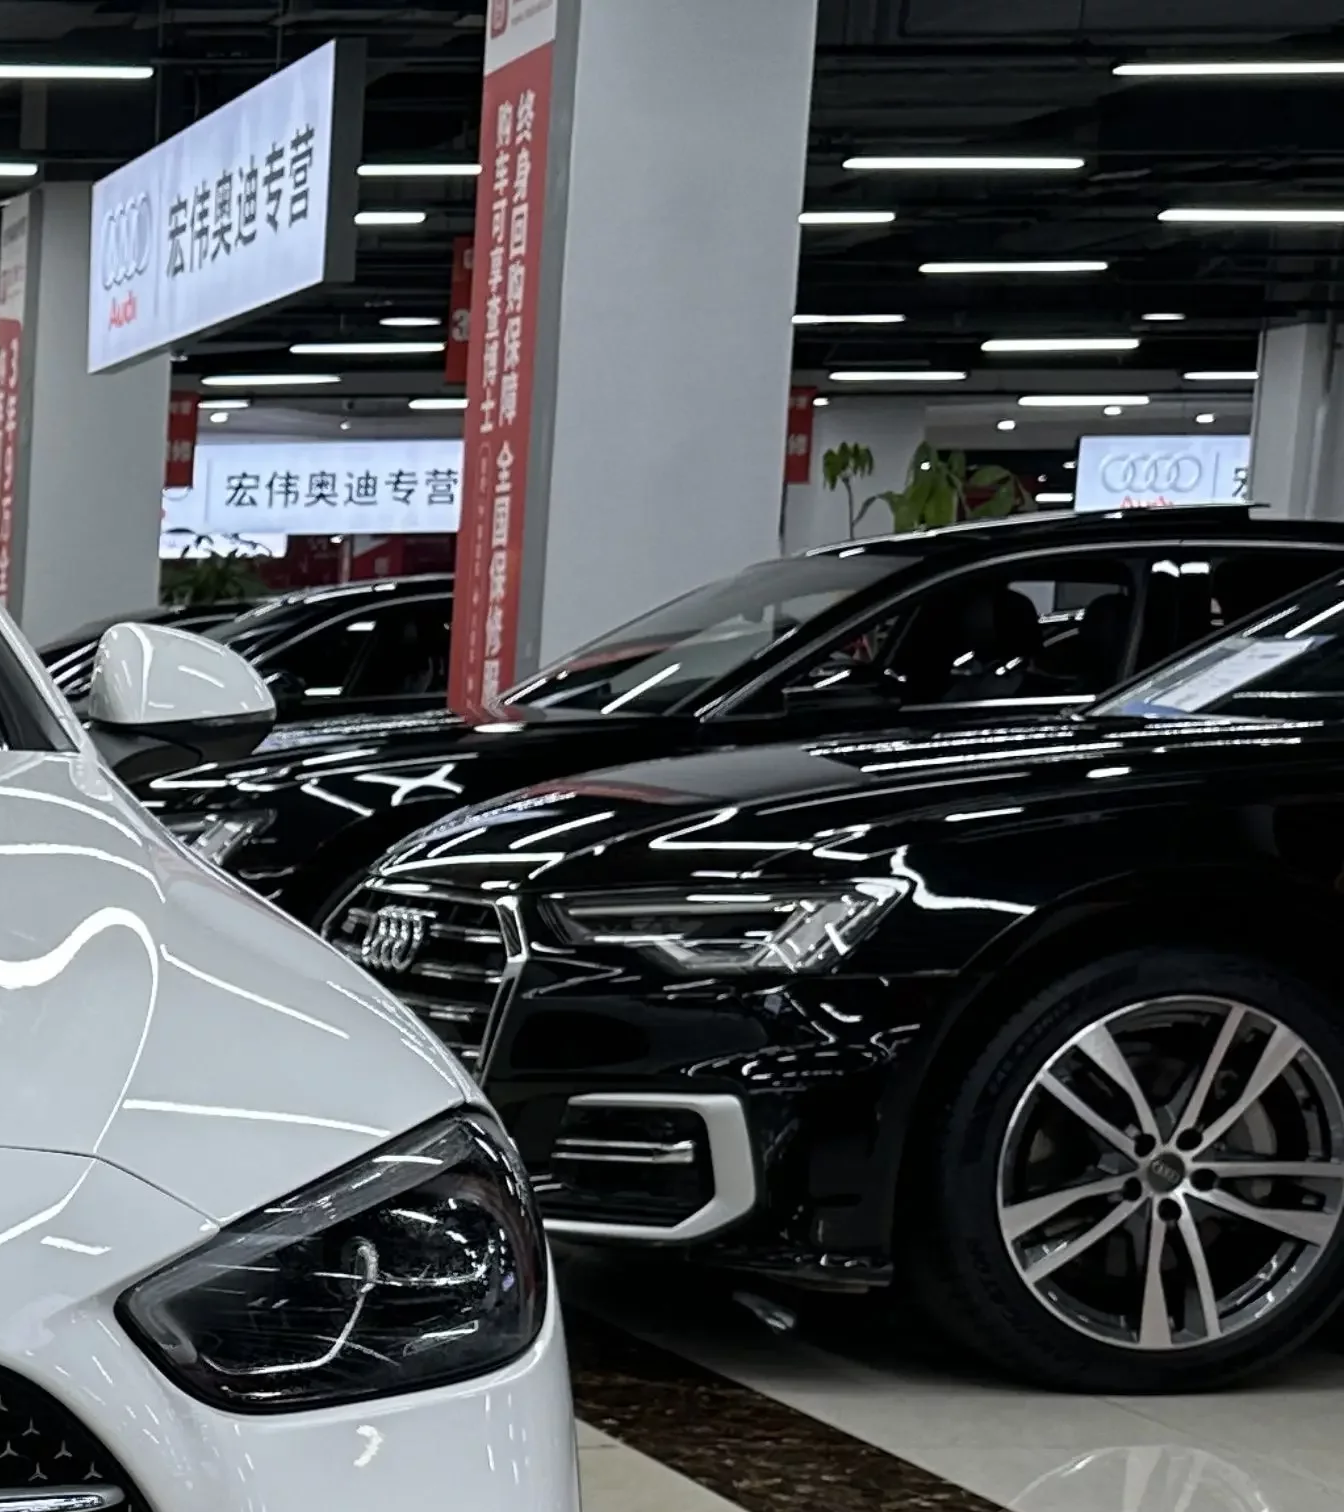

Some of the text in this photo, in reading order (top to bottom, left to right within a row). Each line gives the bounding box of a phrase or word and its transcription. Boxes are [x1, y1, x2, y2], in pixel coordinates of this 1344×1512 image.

[166, 123, 315, 279] 宏伟奥迪专营
[108, 291, 137, 331] Audi
[224, 469, 459, 508] 宏伟奥迪专营
